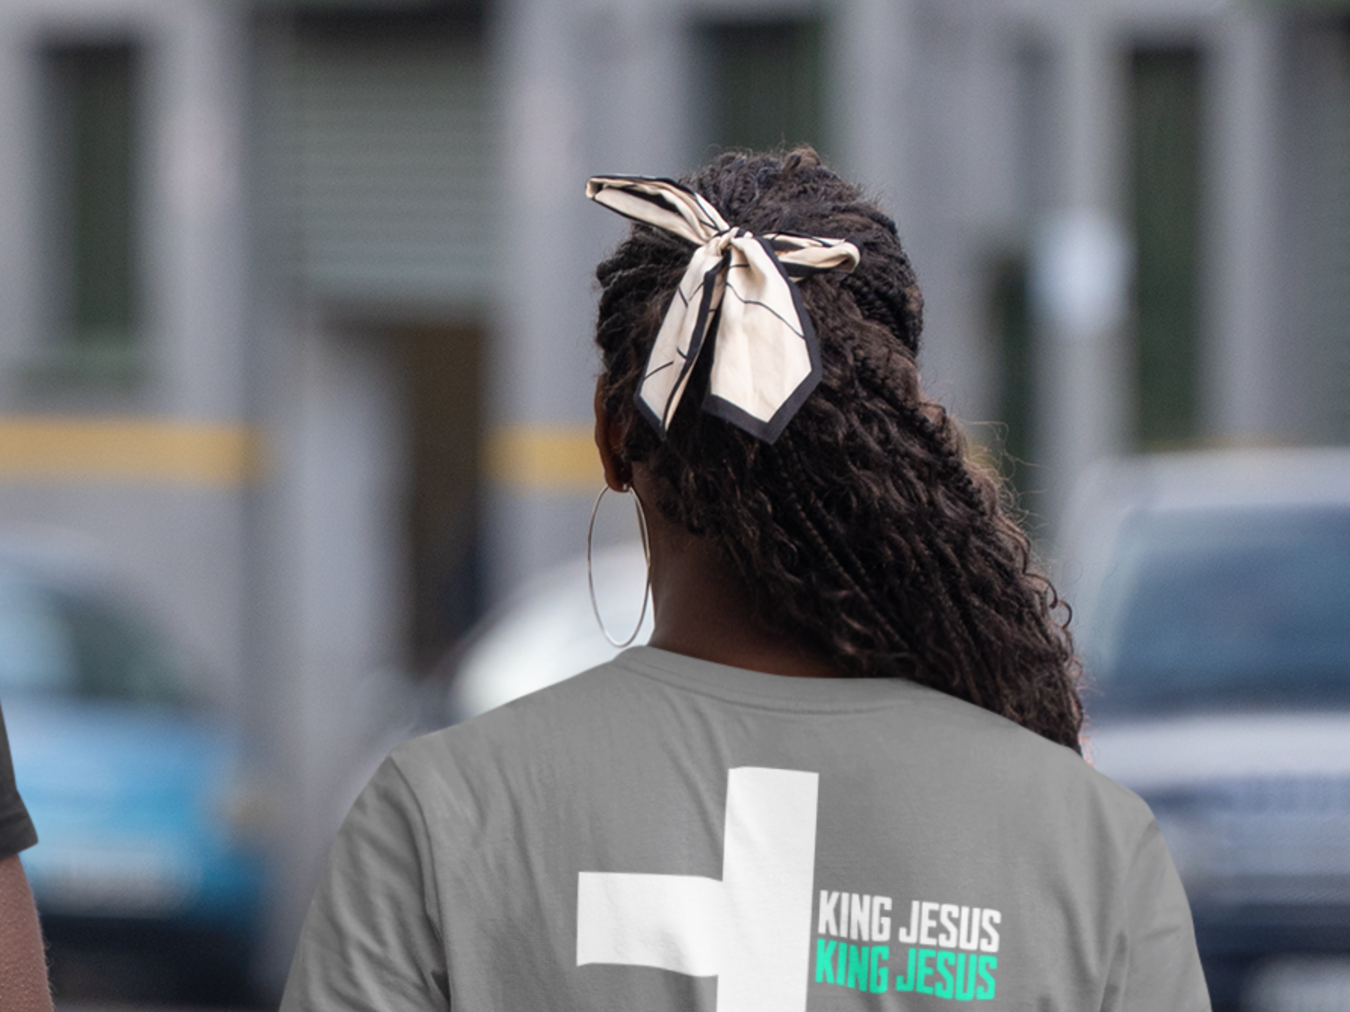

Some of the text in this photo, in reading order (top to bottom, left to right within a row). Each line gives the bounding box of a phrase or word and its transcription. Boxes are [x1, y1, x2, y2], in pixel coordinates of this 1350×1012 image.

[818, 890, 1001, 952] KING JESUS
[815, 938, 998, 1001] KING JESUS
